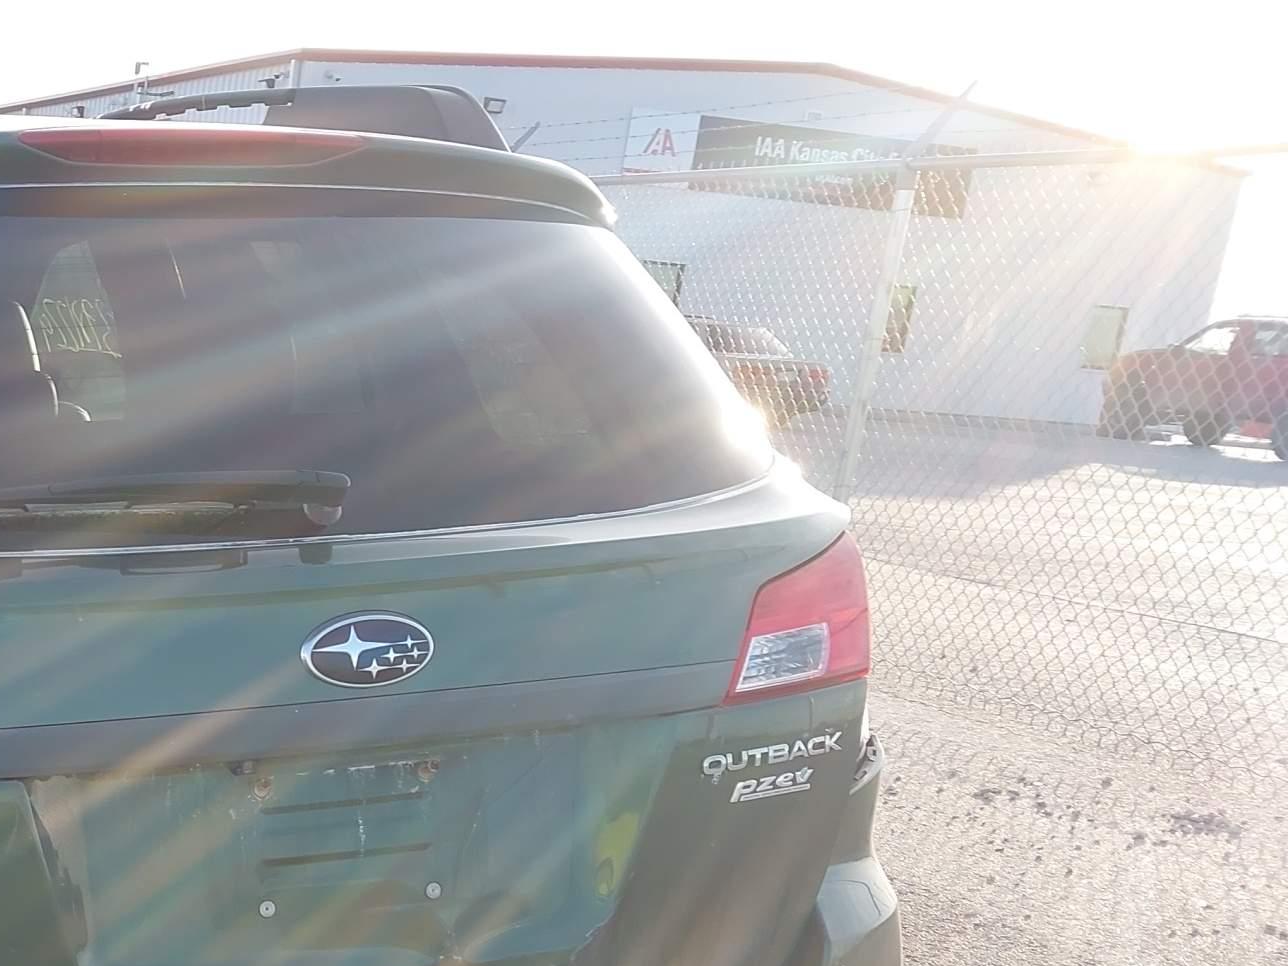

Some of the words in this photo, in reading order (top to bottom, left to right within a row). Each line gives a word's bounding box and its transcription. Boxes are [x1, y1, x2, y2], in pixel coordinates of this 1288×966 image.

[754, 135, 785, 159] IAA
[789, 140, 849, 162] Kansas
[702, 731, 842, 777] OUTBACK
